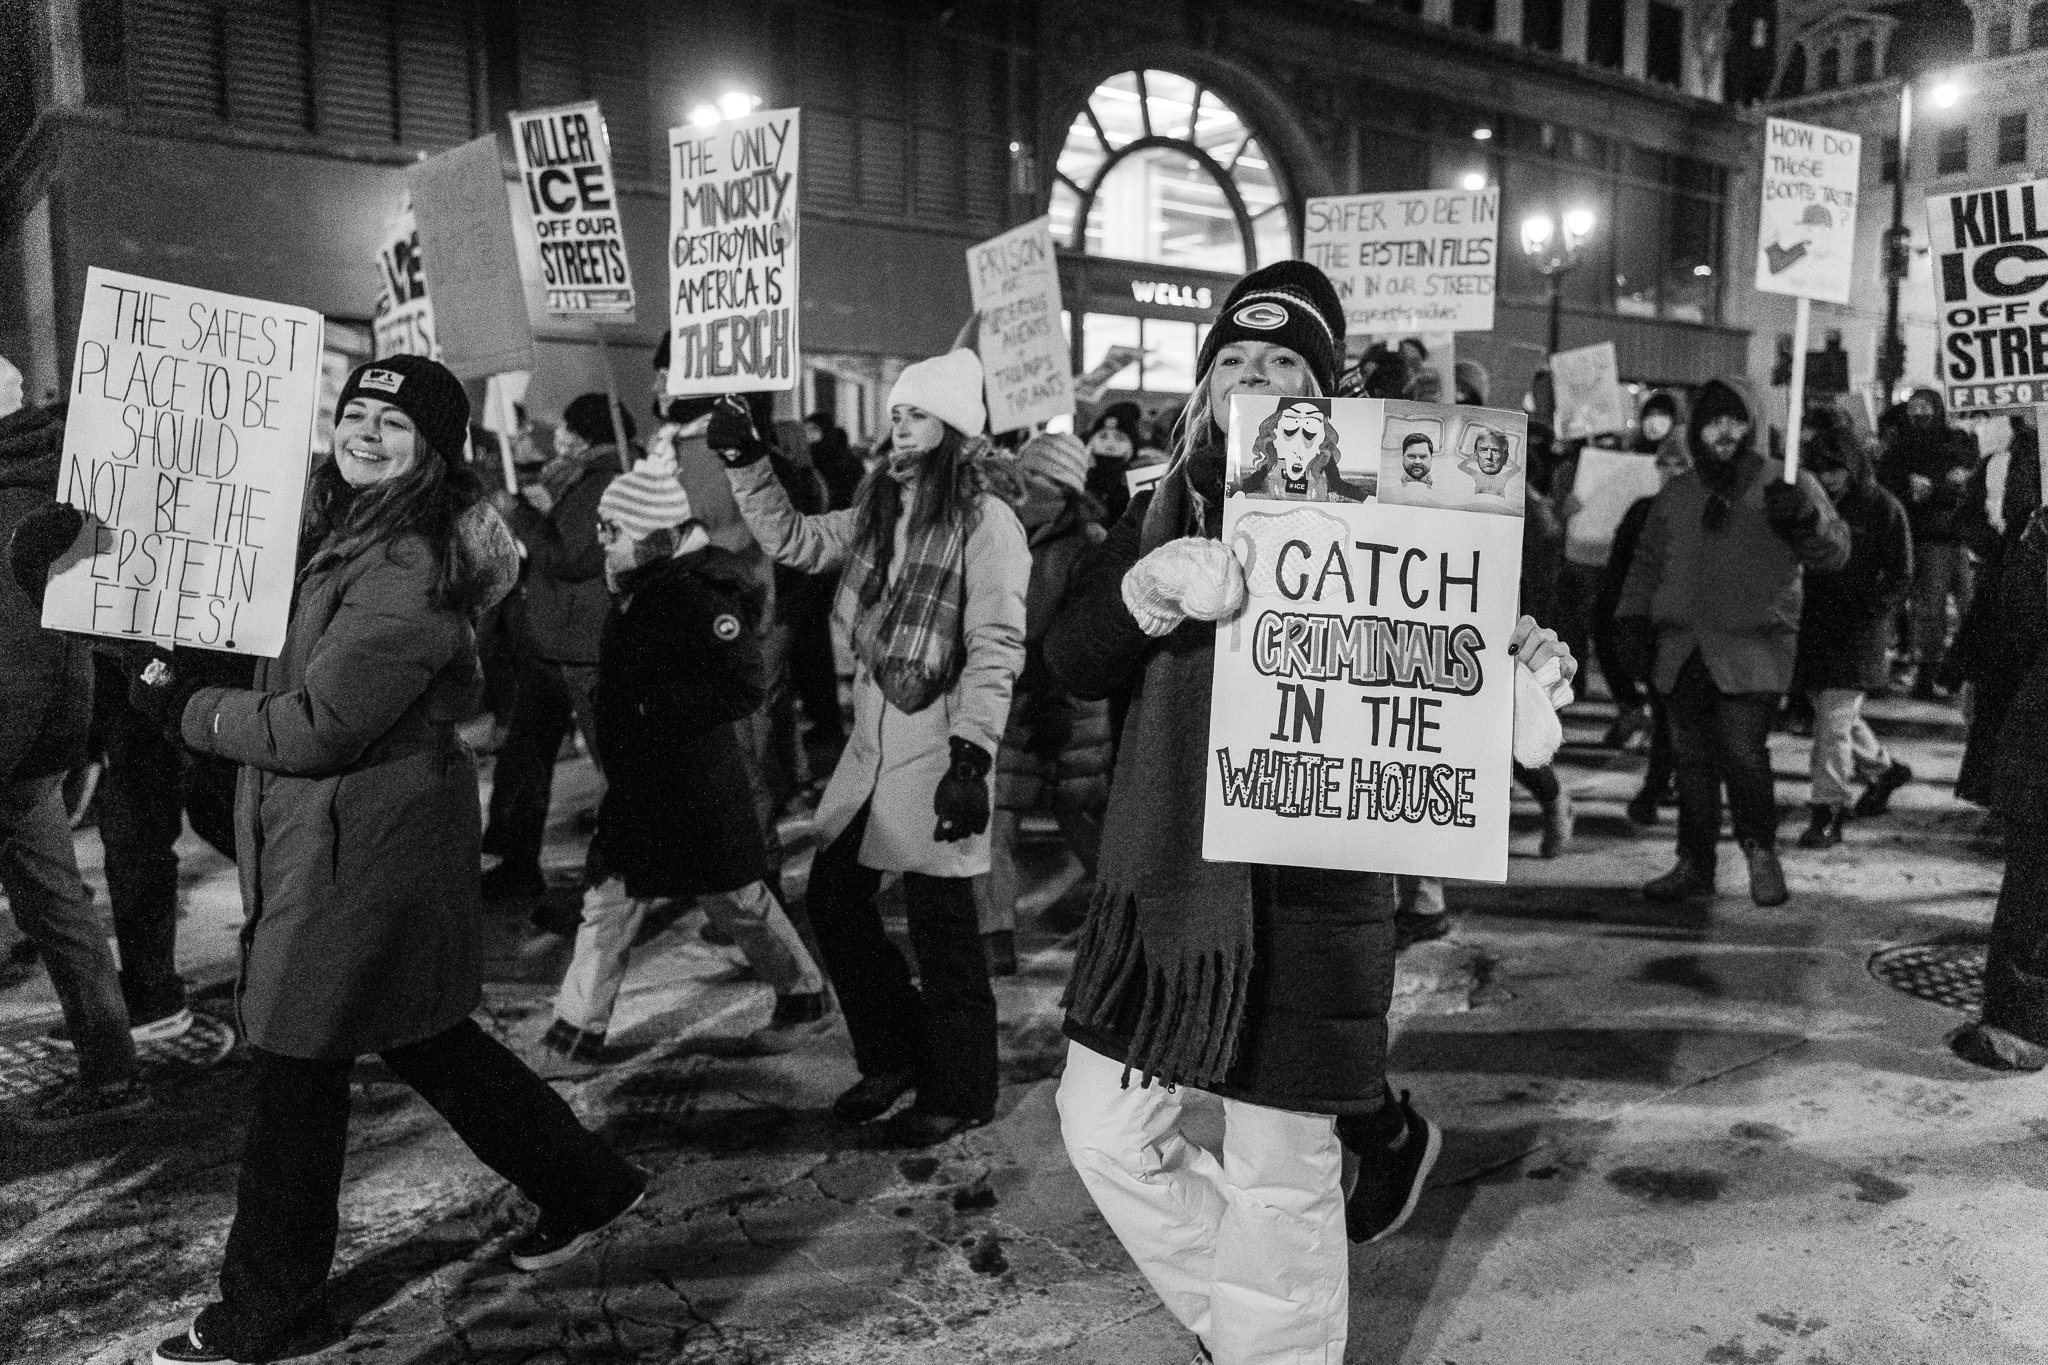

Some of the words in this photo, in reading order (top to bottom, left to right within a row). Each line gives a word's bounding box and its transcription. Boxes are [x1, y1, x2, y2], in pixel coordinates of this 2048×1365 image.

[521, 114, 595, 168] KILLER
[673, 135, 718, 180] THE
[730, 119, 791, 174] ONLY
[1771, 124, 1813, 151] HOW
[1823, 134, 1853, 156] DO
[526, 165, 611, 215] ICE
[1765, 179, 1816, 201] BOOTS
[1770, 154, 1824, 179] THOSE
[683, 167, 792, 230] MINORITY
[1307, 201, 1388, 233] SAFER
[1397, 199, 1429, 228] TO
[1433, 196, 1467, 225] BE
[1471, 193, 1497, 224] IN
[536, 219, 572, 238] OFF
[576, 217, 618, 236] OUR
[673, 222, 786, 269] DESTROYING
[1307, 242, 1351, 269] THE
[1359, 238, 1436, 268] EPSTEIN
[1438, 237, 1494, 268] FILES
[540, 239, 626, 285] STREETS
[977, 229, 1046, 290] PRISON
[1364, 273, 1382, 298] IN
[1386, 275, 1418, 296] OUR
[1423, 272, 1496, 297] STREETS
[675, 266, 759, 316] AMERICA
[764, 266, 783, 306] IS
[1131, 279, 1213, 309] WELLS
[1946, 302, 2030, 328] OFF
[100, 284, 170, 346] THE
[181, 302, 308, 372] SAFEST
[78, 340, 189, 413] PLACE
[197, 361, 231, 420] TO
[242, 370, 283, 431] BE
[1953, 382, 2033, 406] FRSO
[111, 404, 239, 480] SHOULD
[67, 453, 138, 528] NOT
[154, 471, 194, 535] BE
[206, 481, 271, 549] THE
[89, 525, 258, 603] EPSTEIN
[1275, 539, 1481, 613] CATCH
[92, 582, 240, 649] FILES!
[1251, 609, 1487, 696] CRIMINALS
[1269, 681, 1325, 744] IN
[1361, 695, 1443, 754] THE
[1215, 747, 1344, 818] WHITE
[1346, 757, 1476, 828] HOUSE
